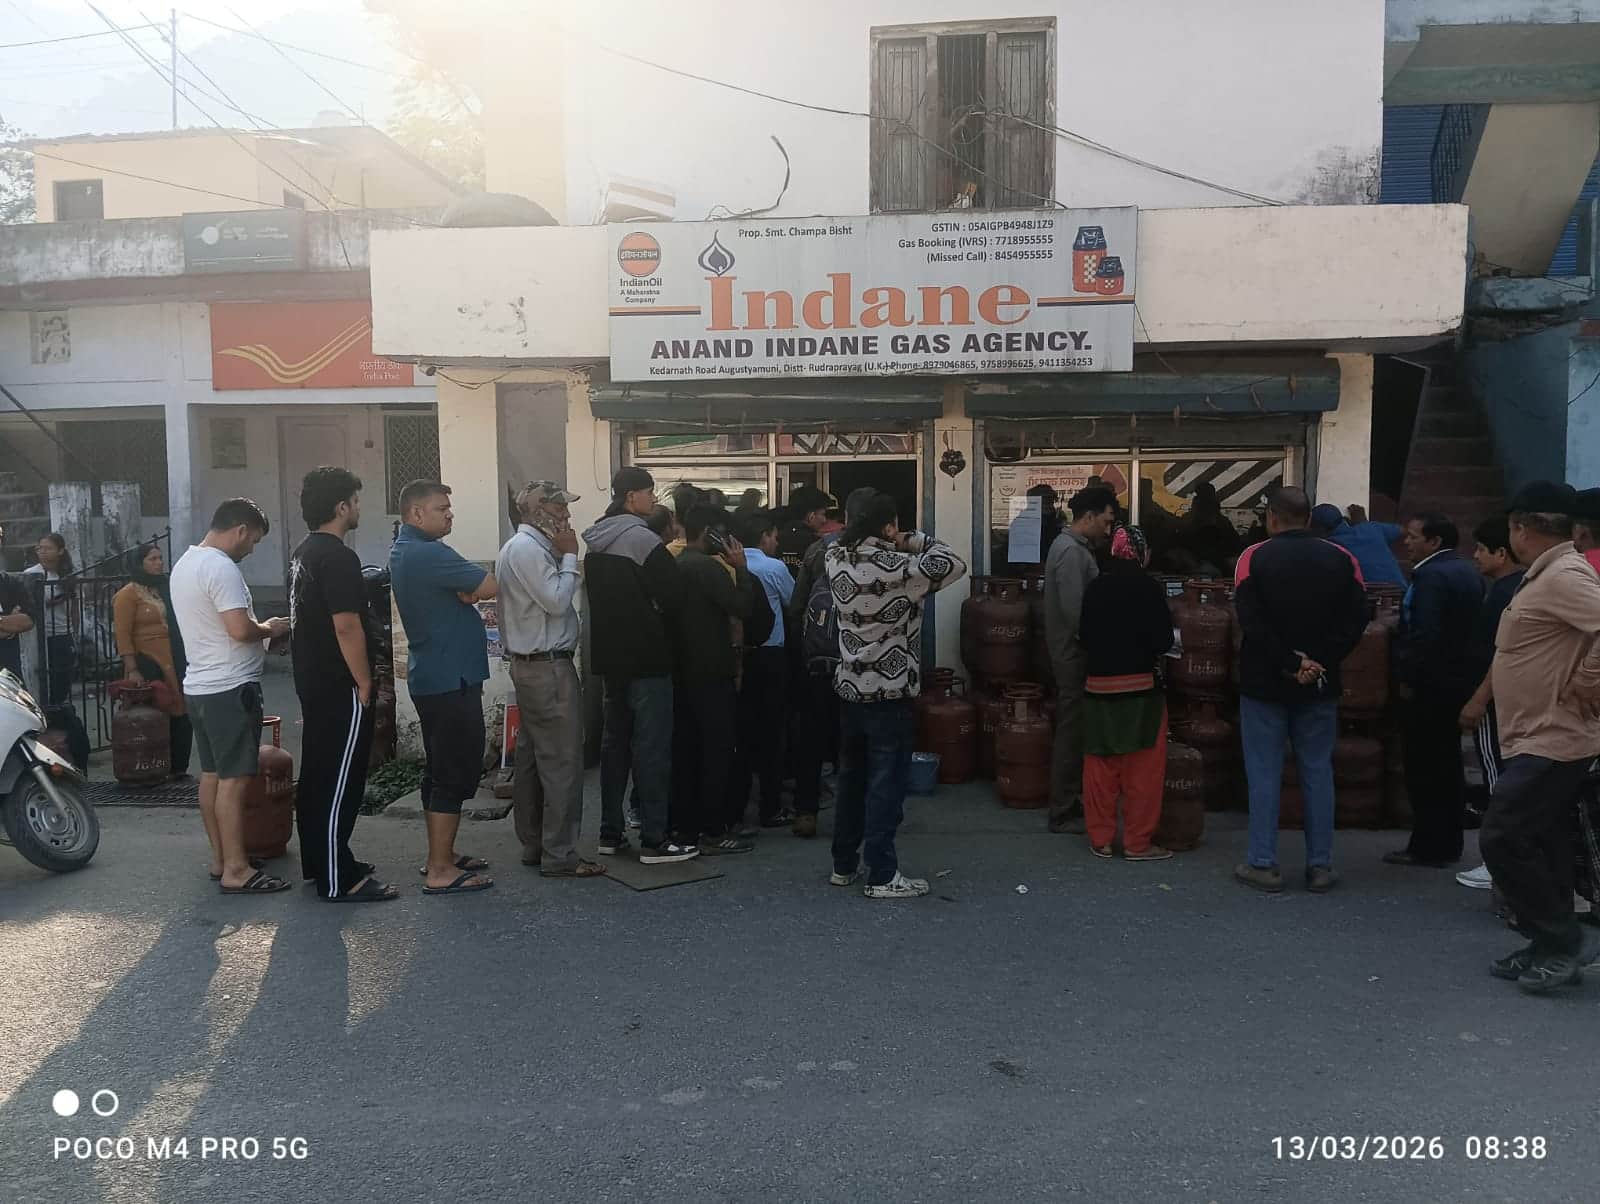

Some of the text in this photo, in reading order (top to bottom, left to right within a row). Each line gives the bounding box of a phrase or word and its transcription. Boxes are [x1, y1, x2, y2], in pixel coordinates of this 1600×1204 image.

[738, 225, 853, 239] Prop. Smt. Champa Bisht
[931, 222, 960, 233] GSTIN
[898, 239, 916, 248] Gas
[918, 237, 957, 249] Booking
[959, 236, 988, 249] (IVRS)
[996, 235, 1054, 246] 7718955555
[927, 252, 964, 264] (Missed
[967, 251, 988, 262] Call)
[996, 249, 1054, 261] 8454955555
[619, 277, 662, 288] IndianOil
[625, 296, 656, 304] Company
[704, 272, 1029, 331] Indane
[651, 331, 1092, 359] ANAND INDANE GAS AGENCY.
[649, 365, 692, 375] Kedarnath
[695, 365, 716, 374] Road
[718, 363, 780, 375] Augustyamuni,
[1038, 357, 1092, 368] 9411354253
